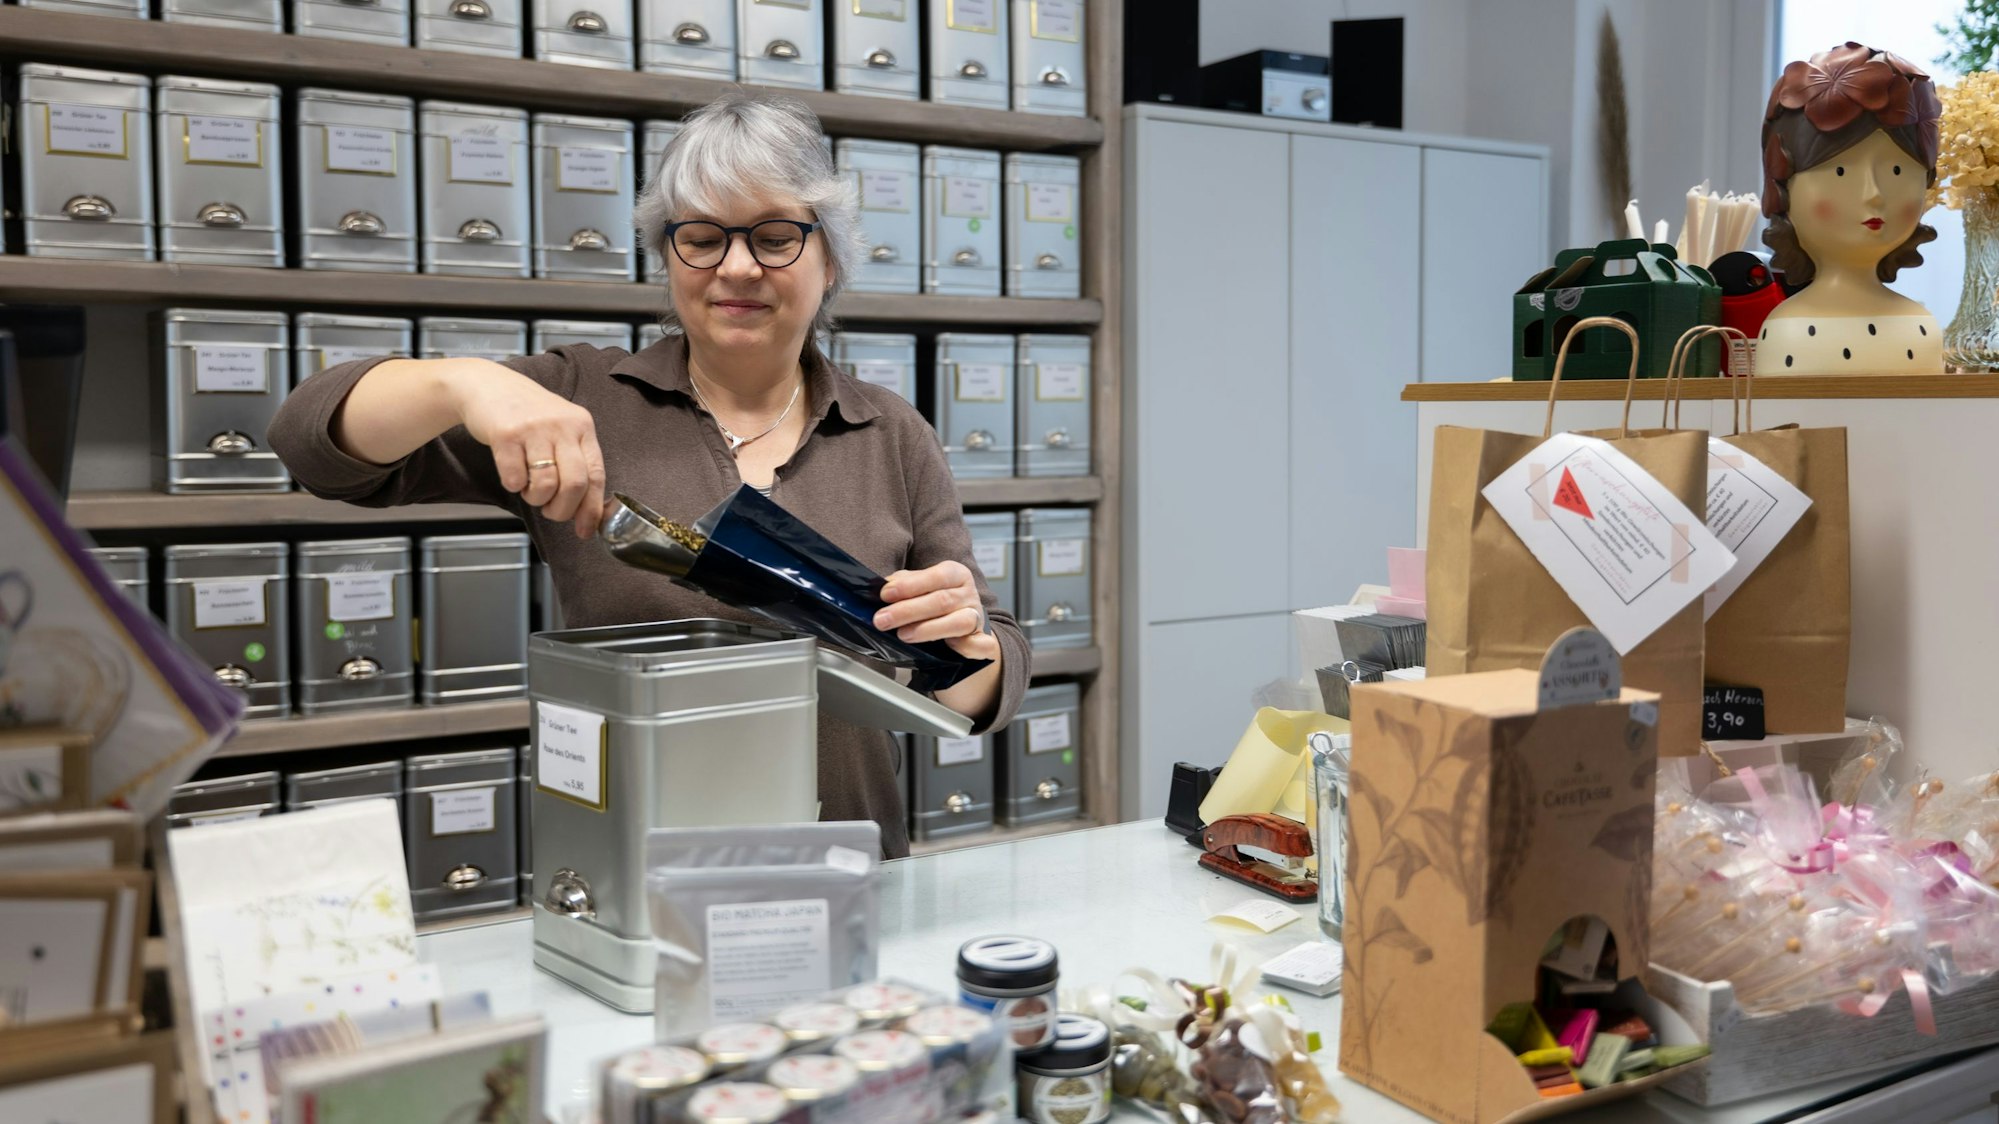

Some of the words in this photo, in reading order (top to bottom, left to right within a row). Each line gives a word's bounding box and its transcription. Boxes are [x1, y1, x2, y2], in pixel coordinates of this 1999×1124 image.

[549, 719, 565, 732] Grüner
[567, 724, 577, 734] Tee
[1707, 712, 1744, 734] 3,90
[564, 749, 586, 763] Orients
[734, 907, 781, 919] MATCHA
[785, 904, 823, 917] JAPAN
